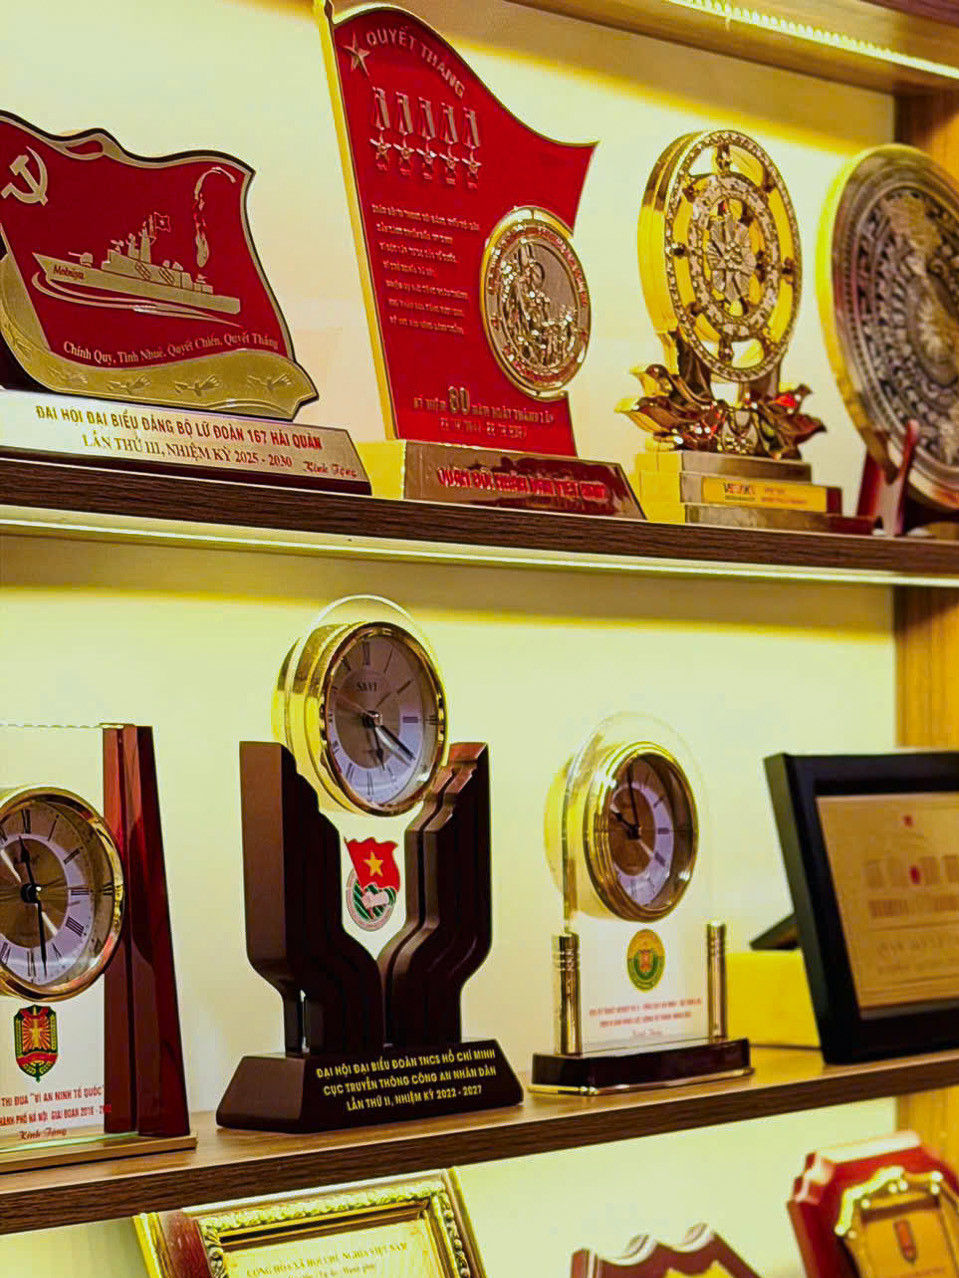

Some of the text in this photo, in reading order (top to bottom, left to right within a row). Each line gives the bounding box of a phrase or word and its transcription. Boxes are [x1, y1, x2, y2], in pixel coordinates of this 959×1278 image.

[63, 340, 92, 360] Chính
[110, 408, 139, 430] BIỂU
[141, 414, 174, 434] ĐẢNG
[176, 419, 193, 438] BỘ
[195, 421, 211, 439] LỮ
[213, 422, 245, 442] ĐOÀN
[247, 429, 268, 445] 167
[270, 430, 291, 447] HẢI
[292, 432, 323, 450] QUÂN
[166, 441, 212, 462] NHIỆM
[212, 446, 232, 463] KỲ
[234, 450, 259, 464] 2025
[268, 453, 294, 468] 2030
[316, 1048, 496, 1080] ĐẠI HỘI ĐẠI BIỂU ĐOÀN TNCS HỒ CHÍ MINH
[323, 1064, 497, 1098] CỤC TRUYỀN THÔNG CÔNG AN NHÂN DÂN
[55, 1090, 73, 1101] NINH
[346, 1096, 365, 1112] LẦN
[365, 1096, 383, 1109] THỨ
[384, 1097, 394, 1107] II,
[395, 1091, 422, 1106] NHIỆM
[423, 1088, 435, 1101] KỲ
[436, 1086, 457, 1100] 2022
[463, 1084, 482, 1097] 2027
